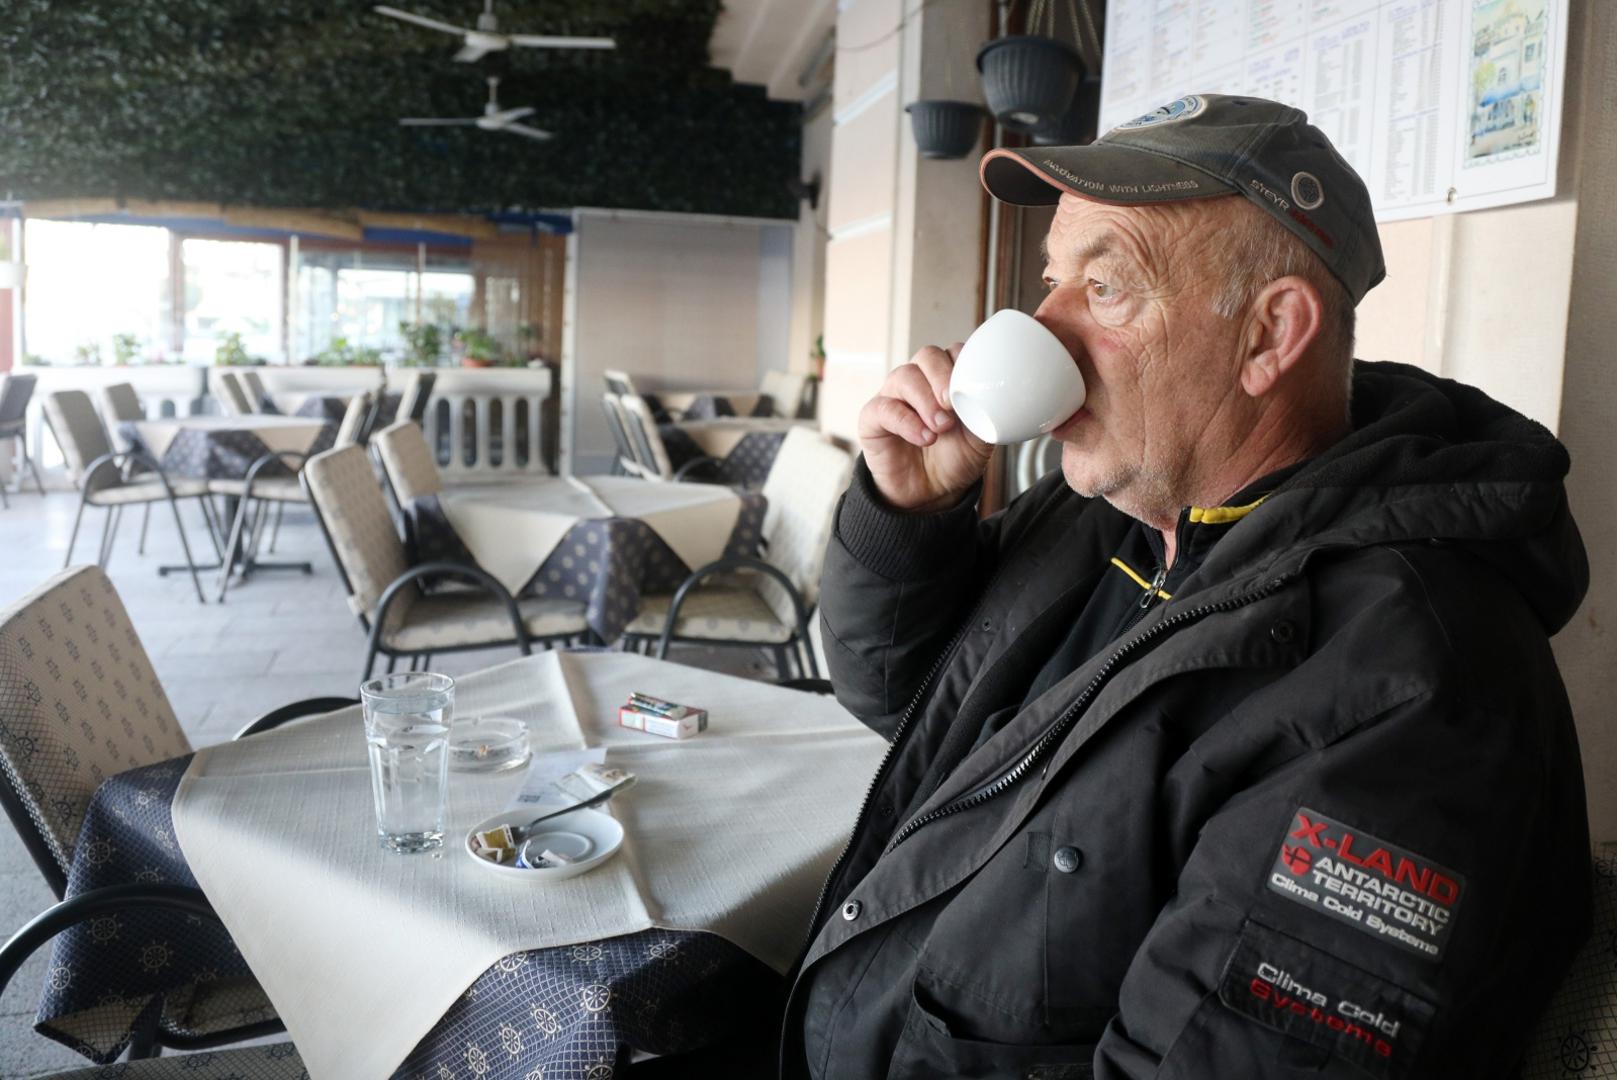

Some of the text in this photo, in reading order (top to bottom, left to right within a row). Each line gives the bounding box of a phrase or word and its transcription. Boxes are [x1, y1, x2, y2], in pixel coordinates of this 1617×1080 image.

[1108, 184, 1139, 193] WITH
[1142, 180, 1199, 193] LIGHTNESS
[1250, 179, 1290, 211] STEYR
[1289, 813, 1459, 905] X-LAND
[1315, 857, 1450, 924] ANTARCTIC
[1271, 872, 1440, 955] Clima Cold Systems
[1312, 869, 1445, 937] TERRITORY
[1250, 978, 1393, 1057] Systems
[1257, 962, 1401, 1038] Clima Cold
